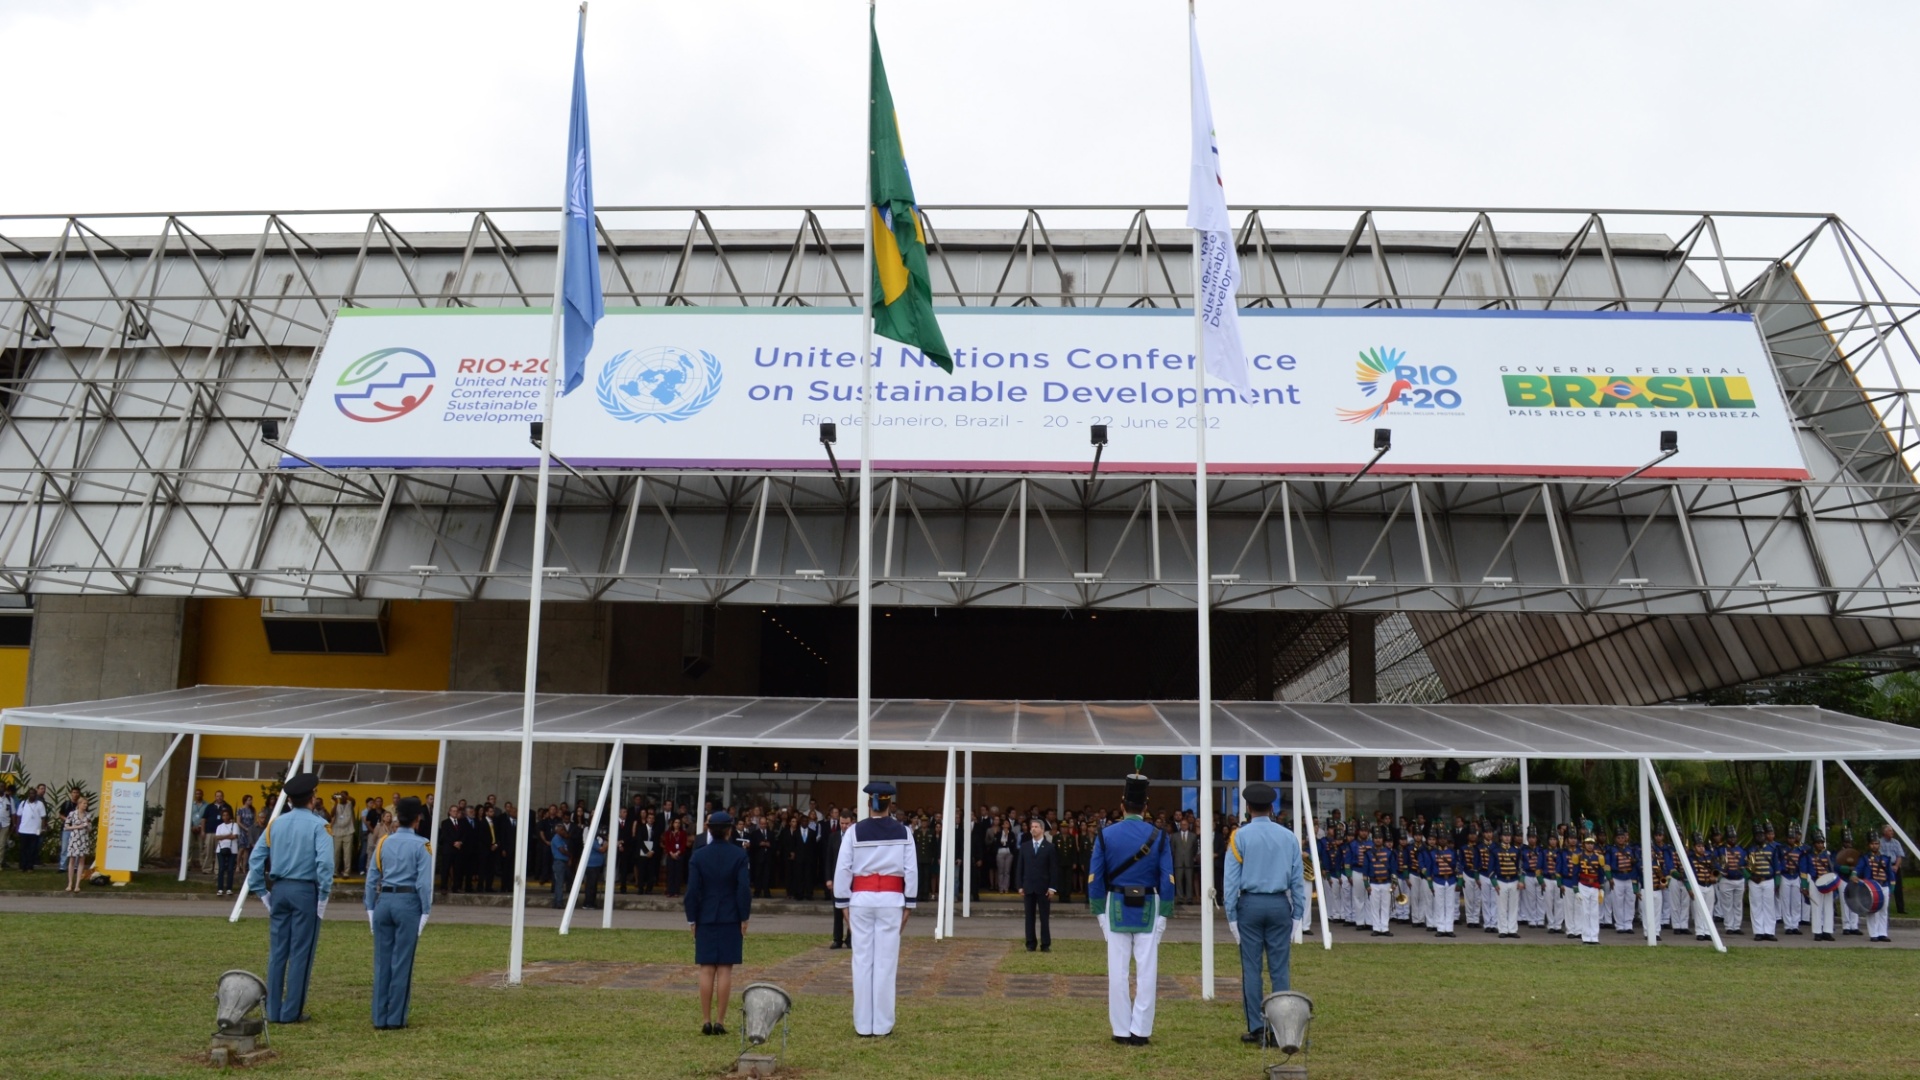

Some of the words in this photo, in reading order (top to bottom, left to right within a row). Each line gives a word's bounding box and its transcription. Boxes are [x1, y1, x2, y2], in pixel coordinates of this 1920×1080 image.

[754, 347, 882, 368] United
[900, 347, 1049, 368] Ntions
[1066, 348, 1296, 370] Conferce
[1395, 365, 1458, 386] RIO
[1499, 366, 1615, 374] GOVERNO
[455, 377, 506, 386] United
[1501, 374, 1756, 408] BRASIL
[451, 388, 540, 398] Conference
[748, 384, 793, 401] on
[807, 380, 1028, 403] Sustainable
[1043, 381, 1300, 408] Development
[1397, 388, 1462, 410] +20
[447, 400, 538, 410] Sustainable
[1509, 409, 1542, 417] PAÍS
[802, 414, 833, 426] Rio
[840, 414, 864, 426] de
[872, 415, 947, 428] Janeiro,
[955, 414, 1009, 427] Brazil
[1043, 416, 1069, 428] 20
[1090, 416, 1114, 428] 22
[1121, 416, 1168, 428] June
[1176, 417, 1220, 428] 2012
[121, 754, 141, 780] 5
[1322, 762, 1338, 782] 5
